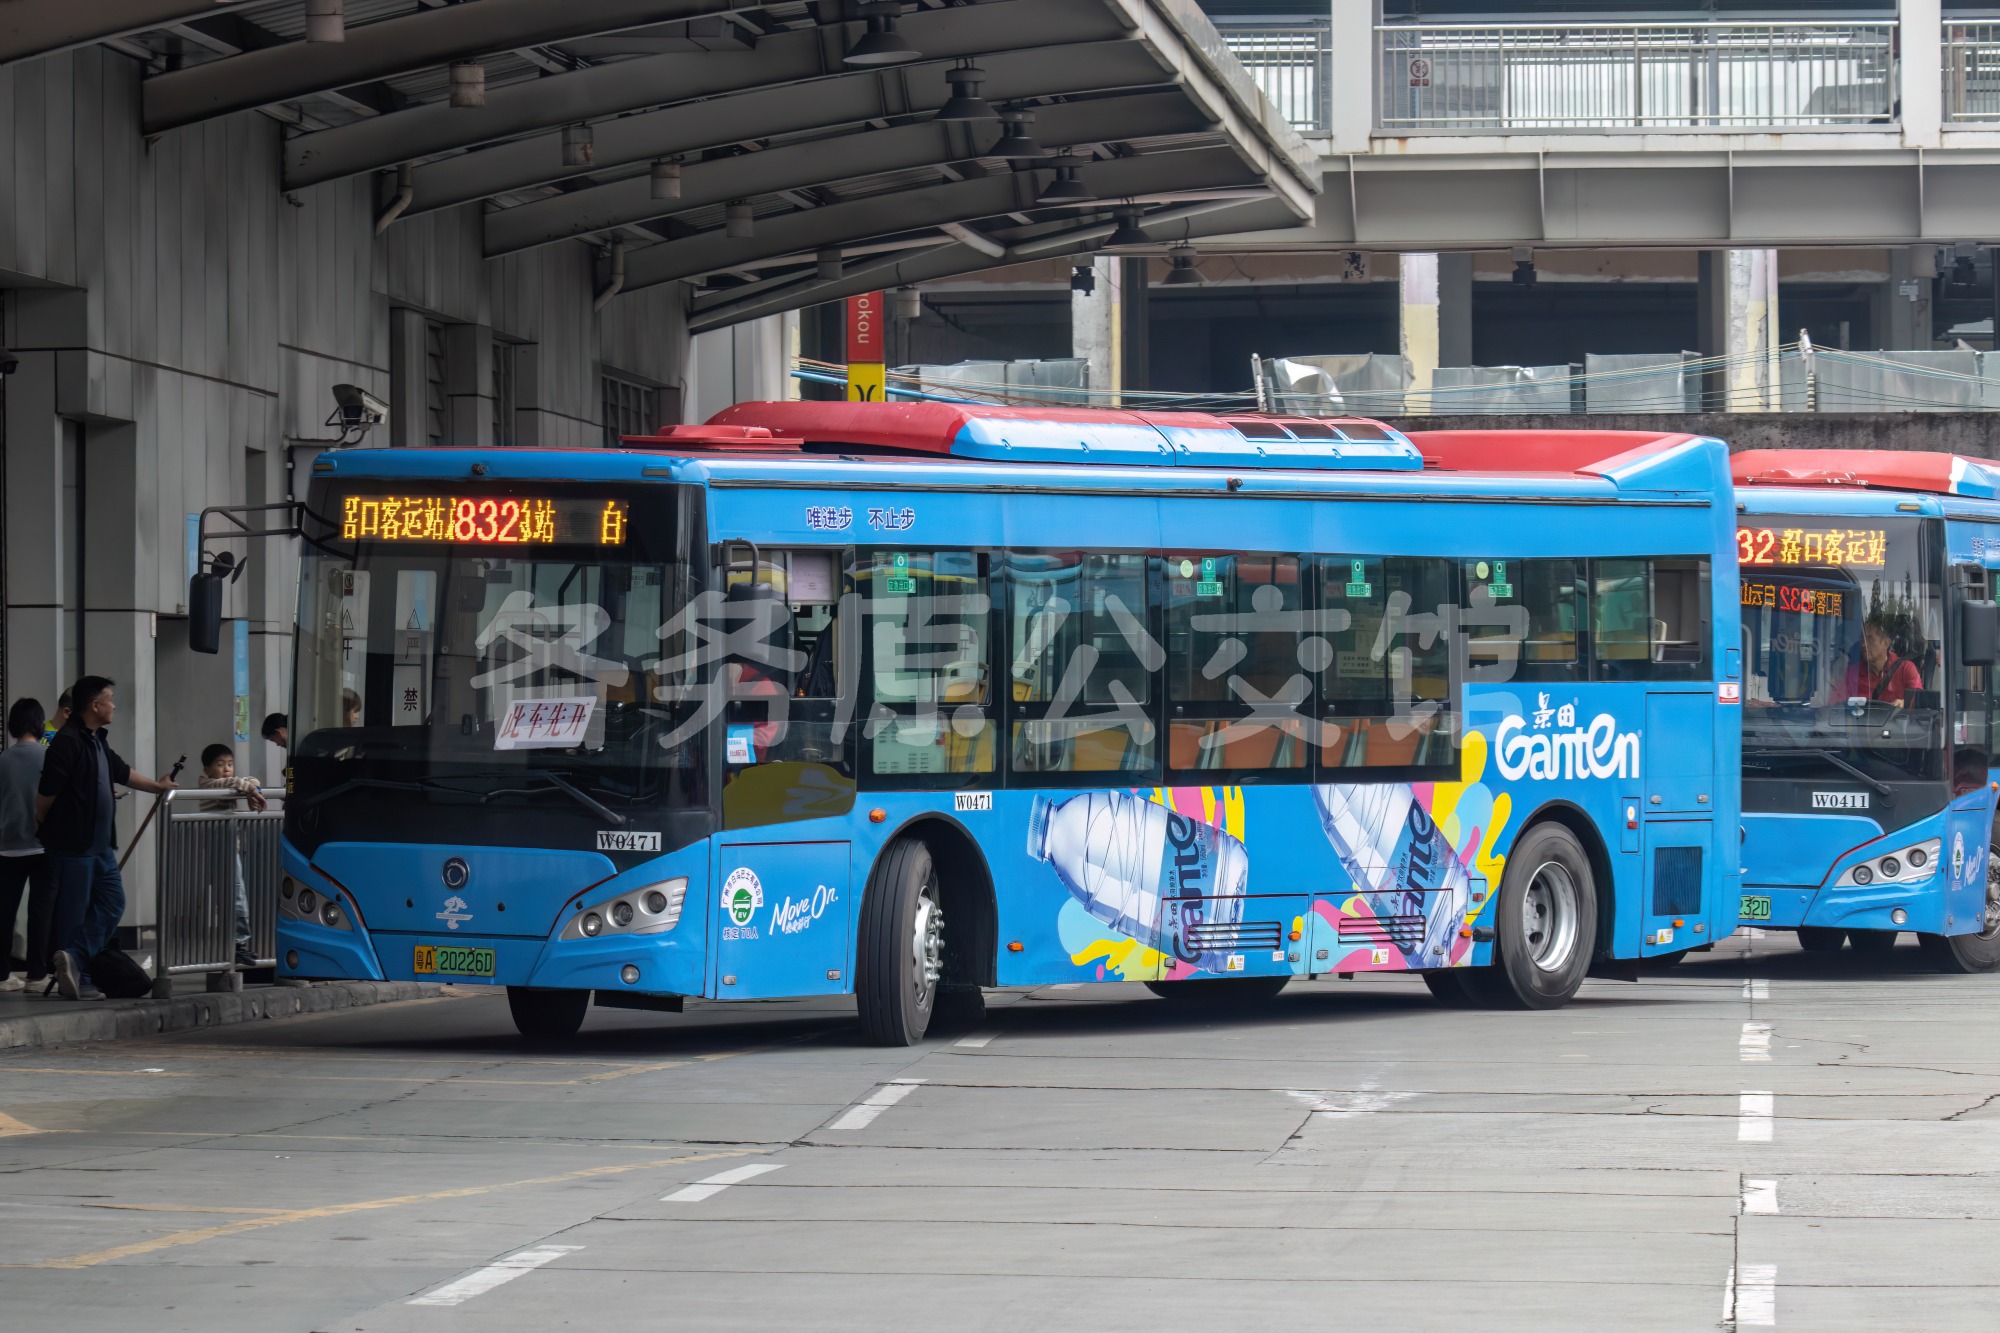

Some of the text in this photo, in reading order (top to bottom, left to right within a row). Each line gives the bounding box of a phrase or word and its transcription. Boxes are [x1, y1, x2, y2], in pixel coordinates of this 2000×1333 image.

[455, 499, 519, 541] 832
[806, 506, 916, 531] 唯进步 不止步
[500, 703, 591, 739] 此车先开
[1532, 691, 1576, 730] 景田
[956, 795, 991, 810] W0471
[1814, 793, 1869, 808] W0411
[598, 833, 659, 850] W0471
[738, 911, 747, 919] EV
[769, 896, 811, 936] Move
[1738, 898, 1770, 918] 32D
[440, 950, 492, 973] 20226D
